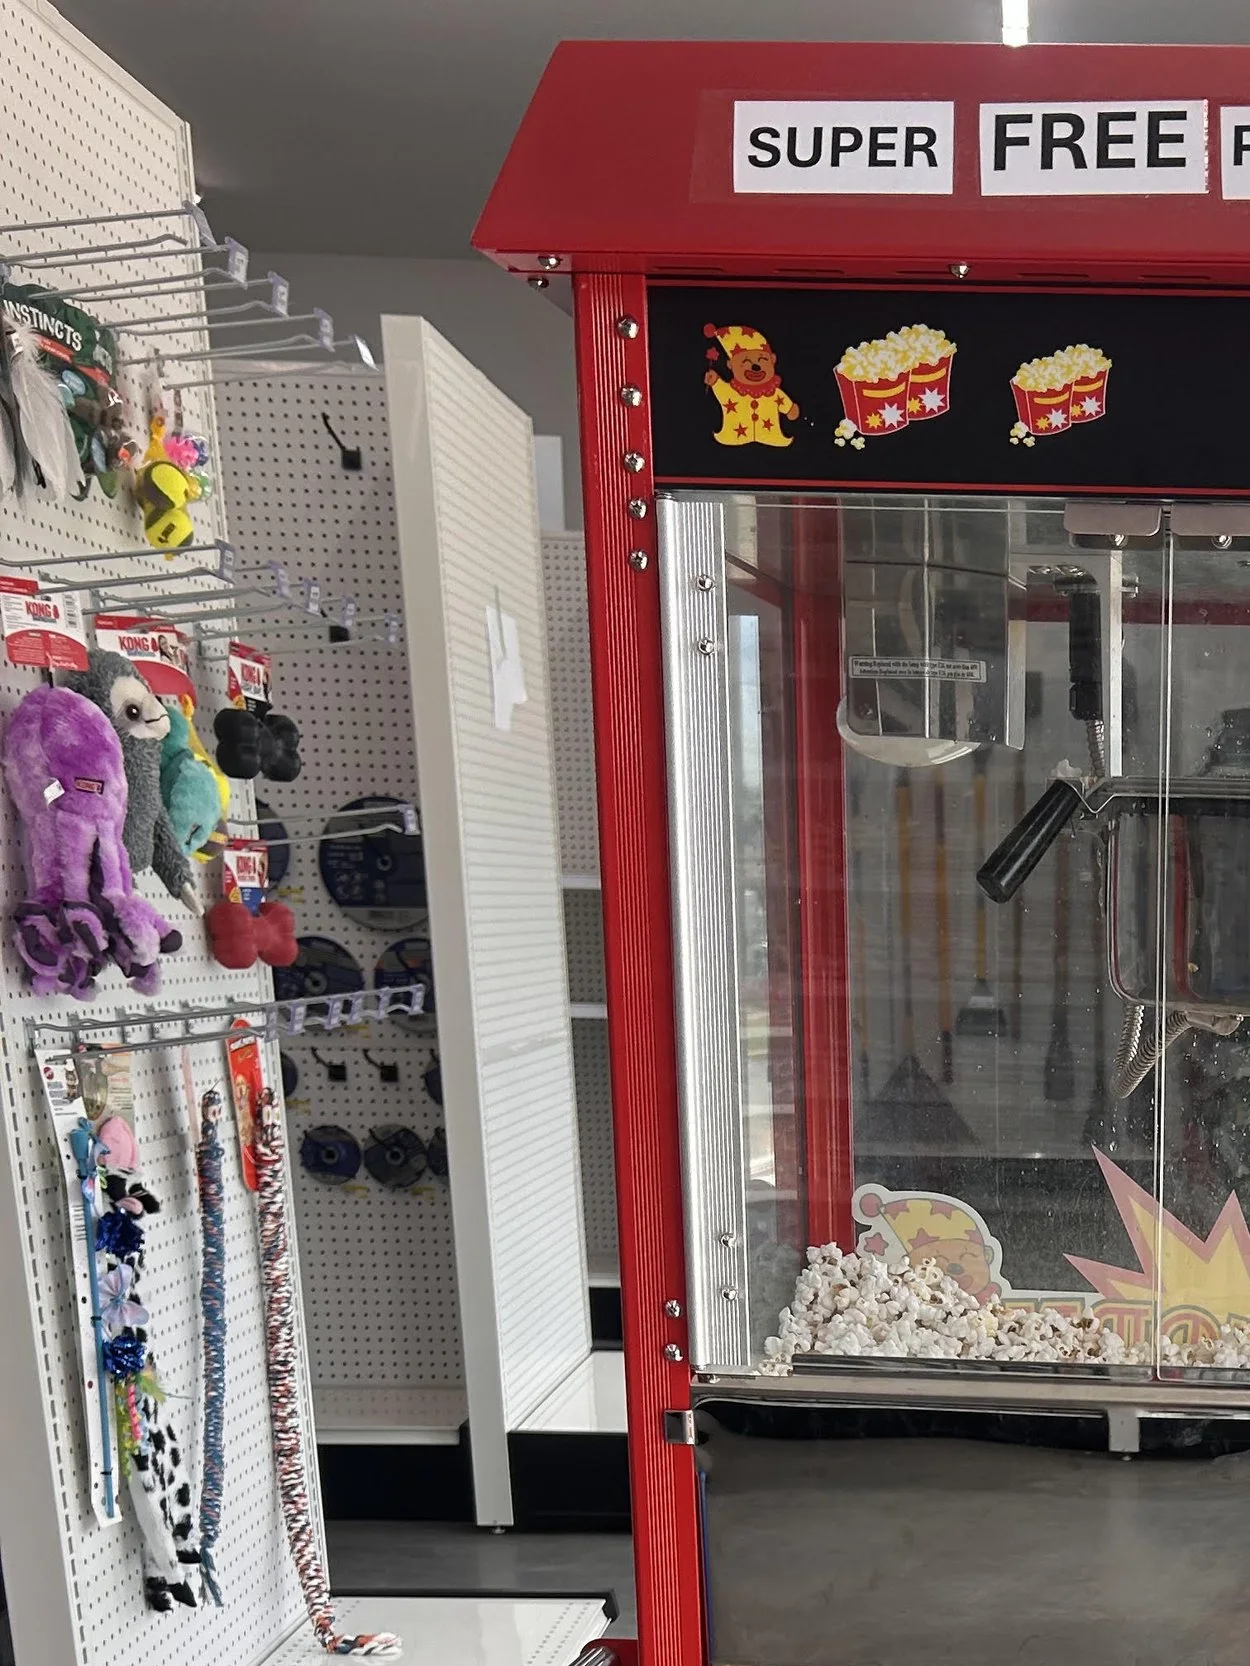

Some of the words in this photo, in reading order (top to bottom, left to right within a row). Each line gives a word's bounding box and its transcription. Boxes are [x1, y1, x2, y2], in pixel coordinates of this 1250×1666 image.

[748, 126, 938, 168] SUPER
[994, 110, 1187, 171] FREE
[3, 299, 82, 351] INSTINCTS
[25, 600, 52, 617] KONG
[118, 635, 149, 651] KONG
